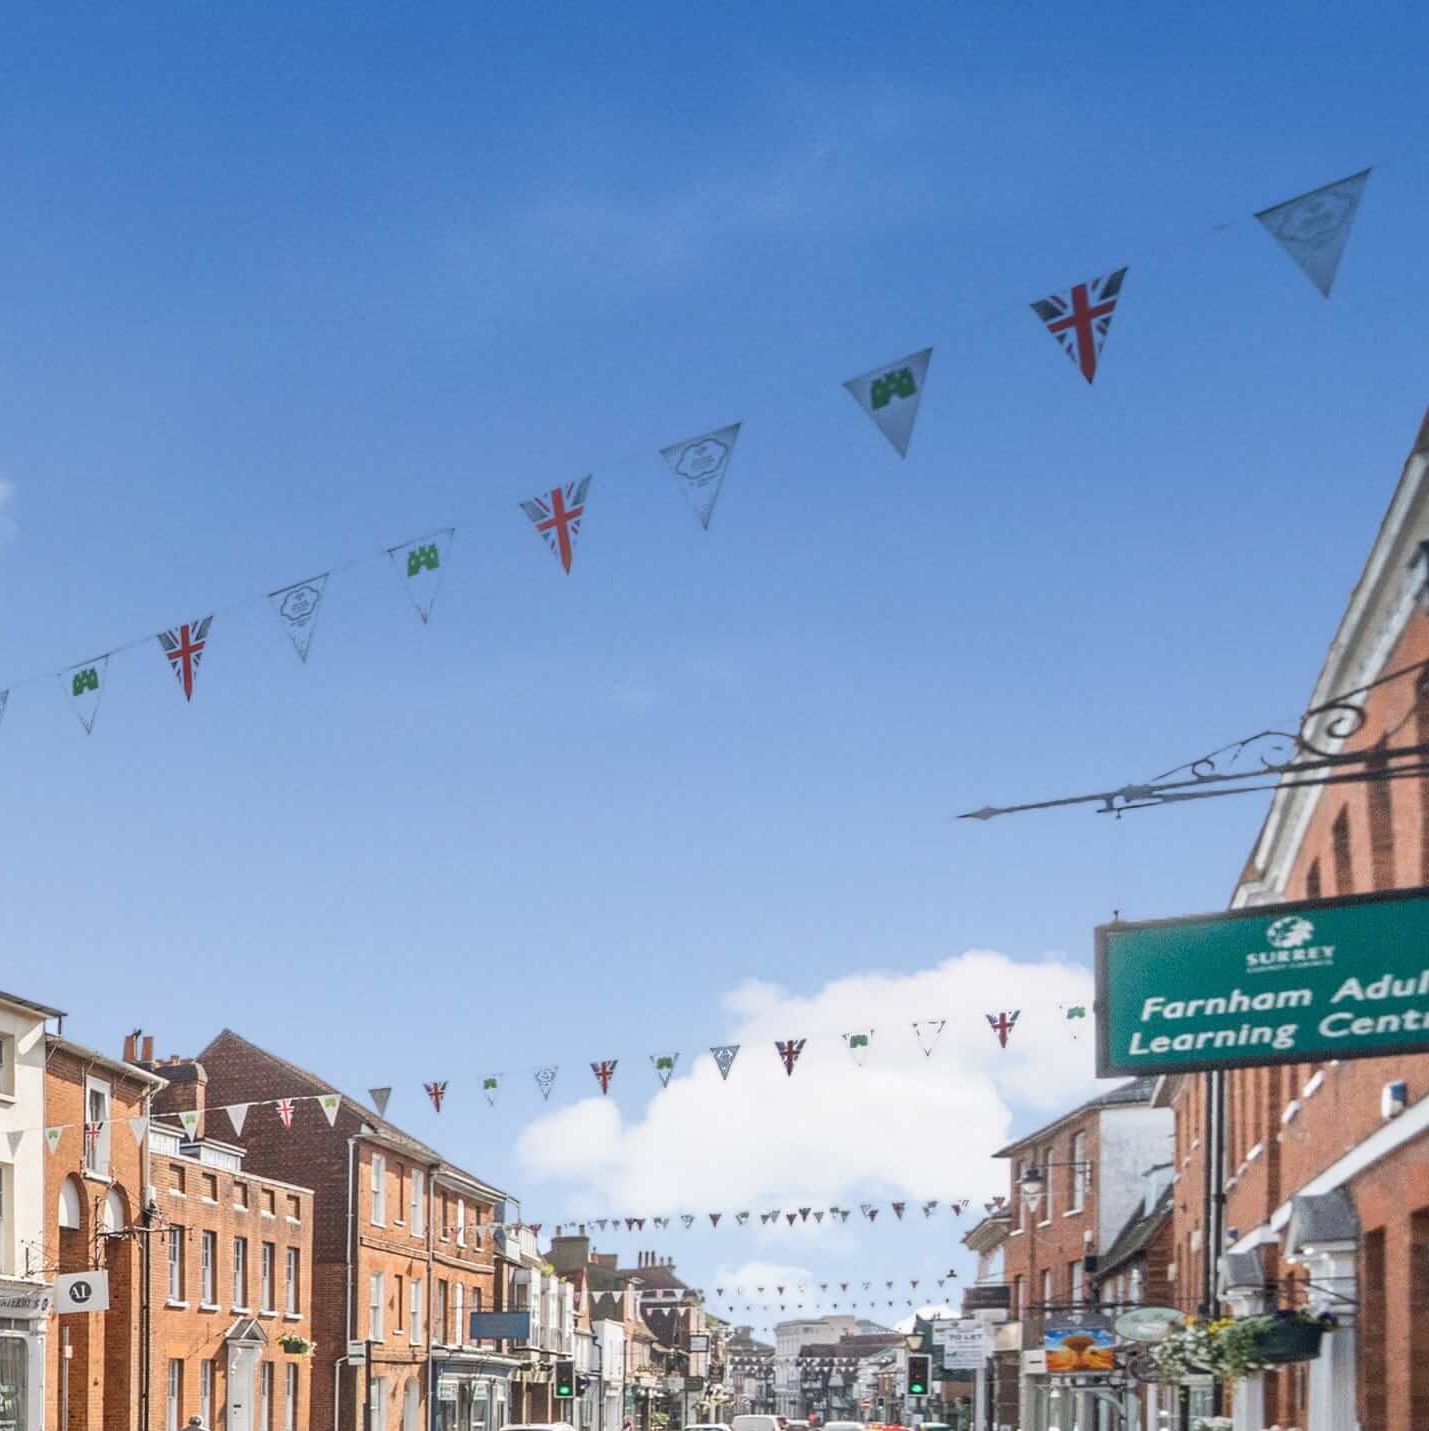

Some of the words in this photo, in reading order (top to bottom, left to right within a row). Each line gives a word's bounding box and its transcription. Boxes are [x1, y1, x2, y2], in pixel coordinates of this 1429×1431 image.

[1246, 945, 1335, 967] SURREY
[1141, 989, 1313, 1022] Farnham
[1128, 1023, 1299, 1056] Learning
